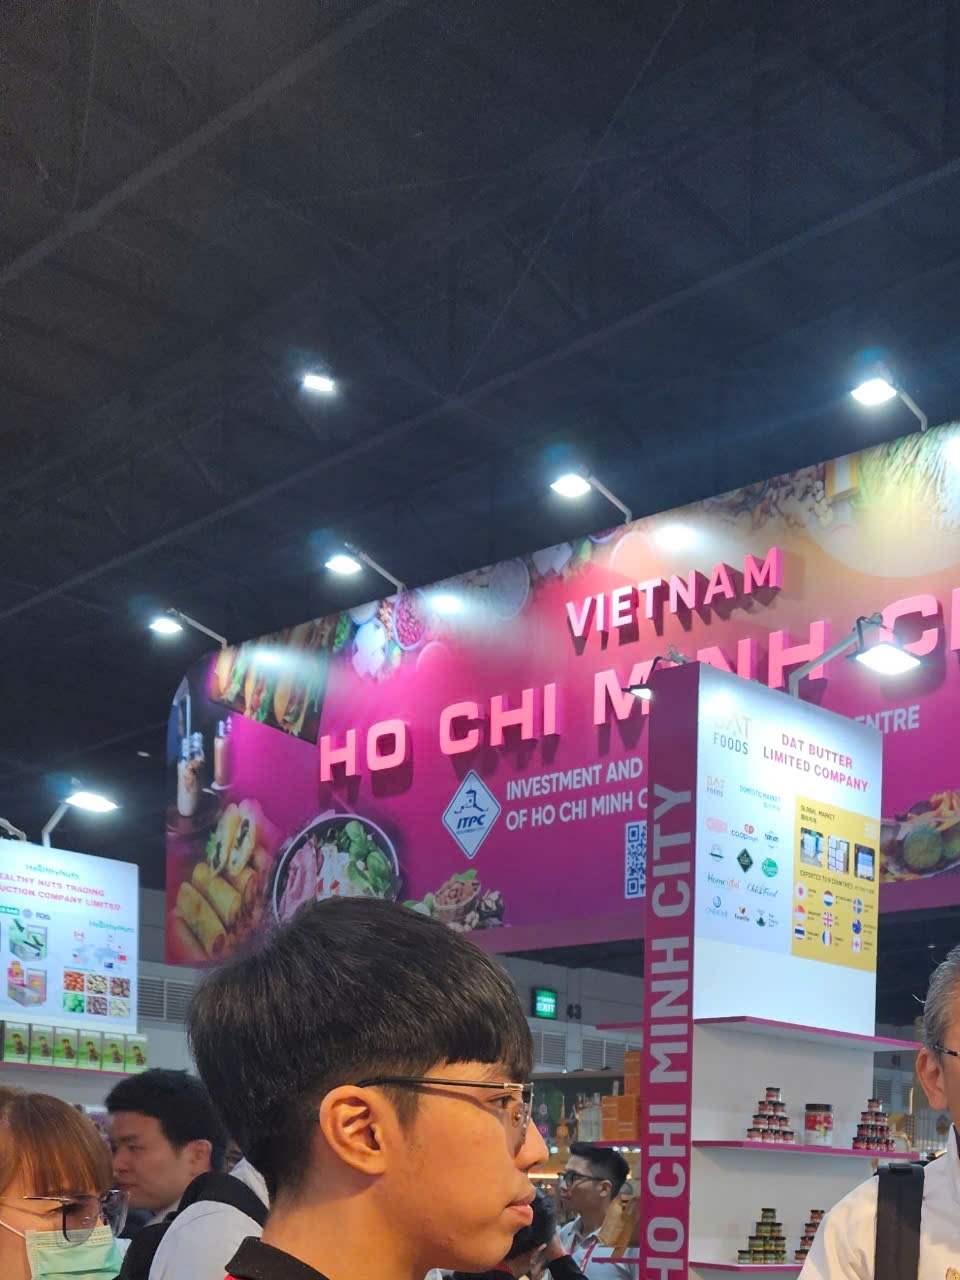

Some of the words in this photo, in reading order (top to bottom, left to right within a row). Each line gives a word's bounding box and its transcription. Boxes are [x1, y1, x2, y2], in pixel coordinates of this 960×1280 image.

[565, 547, 783, 638] VIETNAM
[319, 718, 407, 783] HO
[439, 682, 560, 756] CHI
[593, 619, 831, 726] MNH
[713, 731, 749, 755] FOODS
[781, 733, 805, 752] DAT
[808, 743, 854, 770] BUTTER
[506, 764, 603, 801] INVESTMENT
[606, 757, 644, 783] AND
[763, 746, 811, 773] LIMITED
[813, 764, 869, 793] COMPANY
[457, 814, 486, 829] ITPC
[506, 809, 528, 831] OF
[531, 804, 556, 827] HO
[559, 799, 587, 822] CHI
[591, 790, 633, 818] MINH
[651, 783, 692, 918] CITY
[38, 891, 82, 904] COMPANY
[649, 936, 690, 1084] MINH
[648, 1103, 687, 1198] CHI
